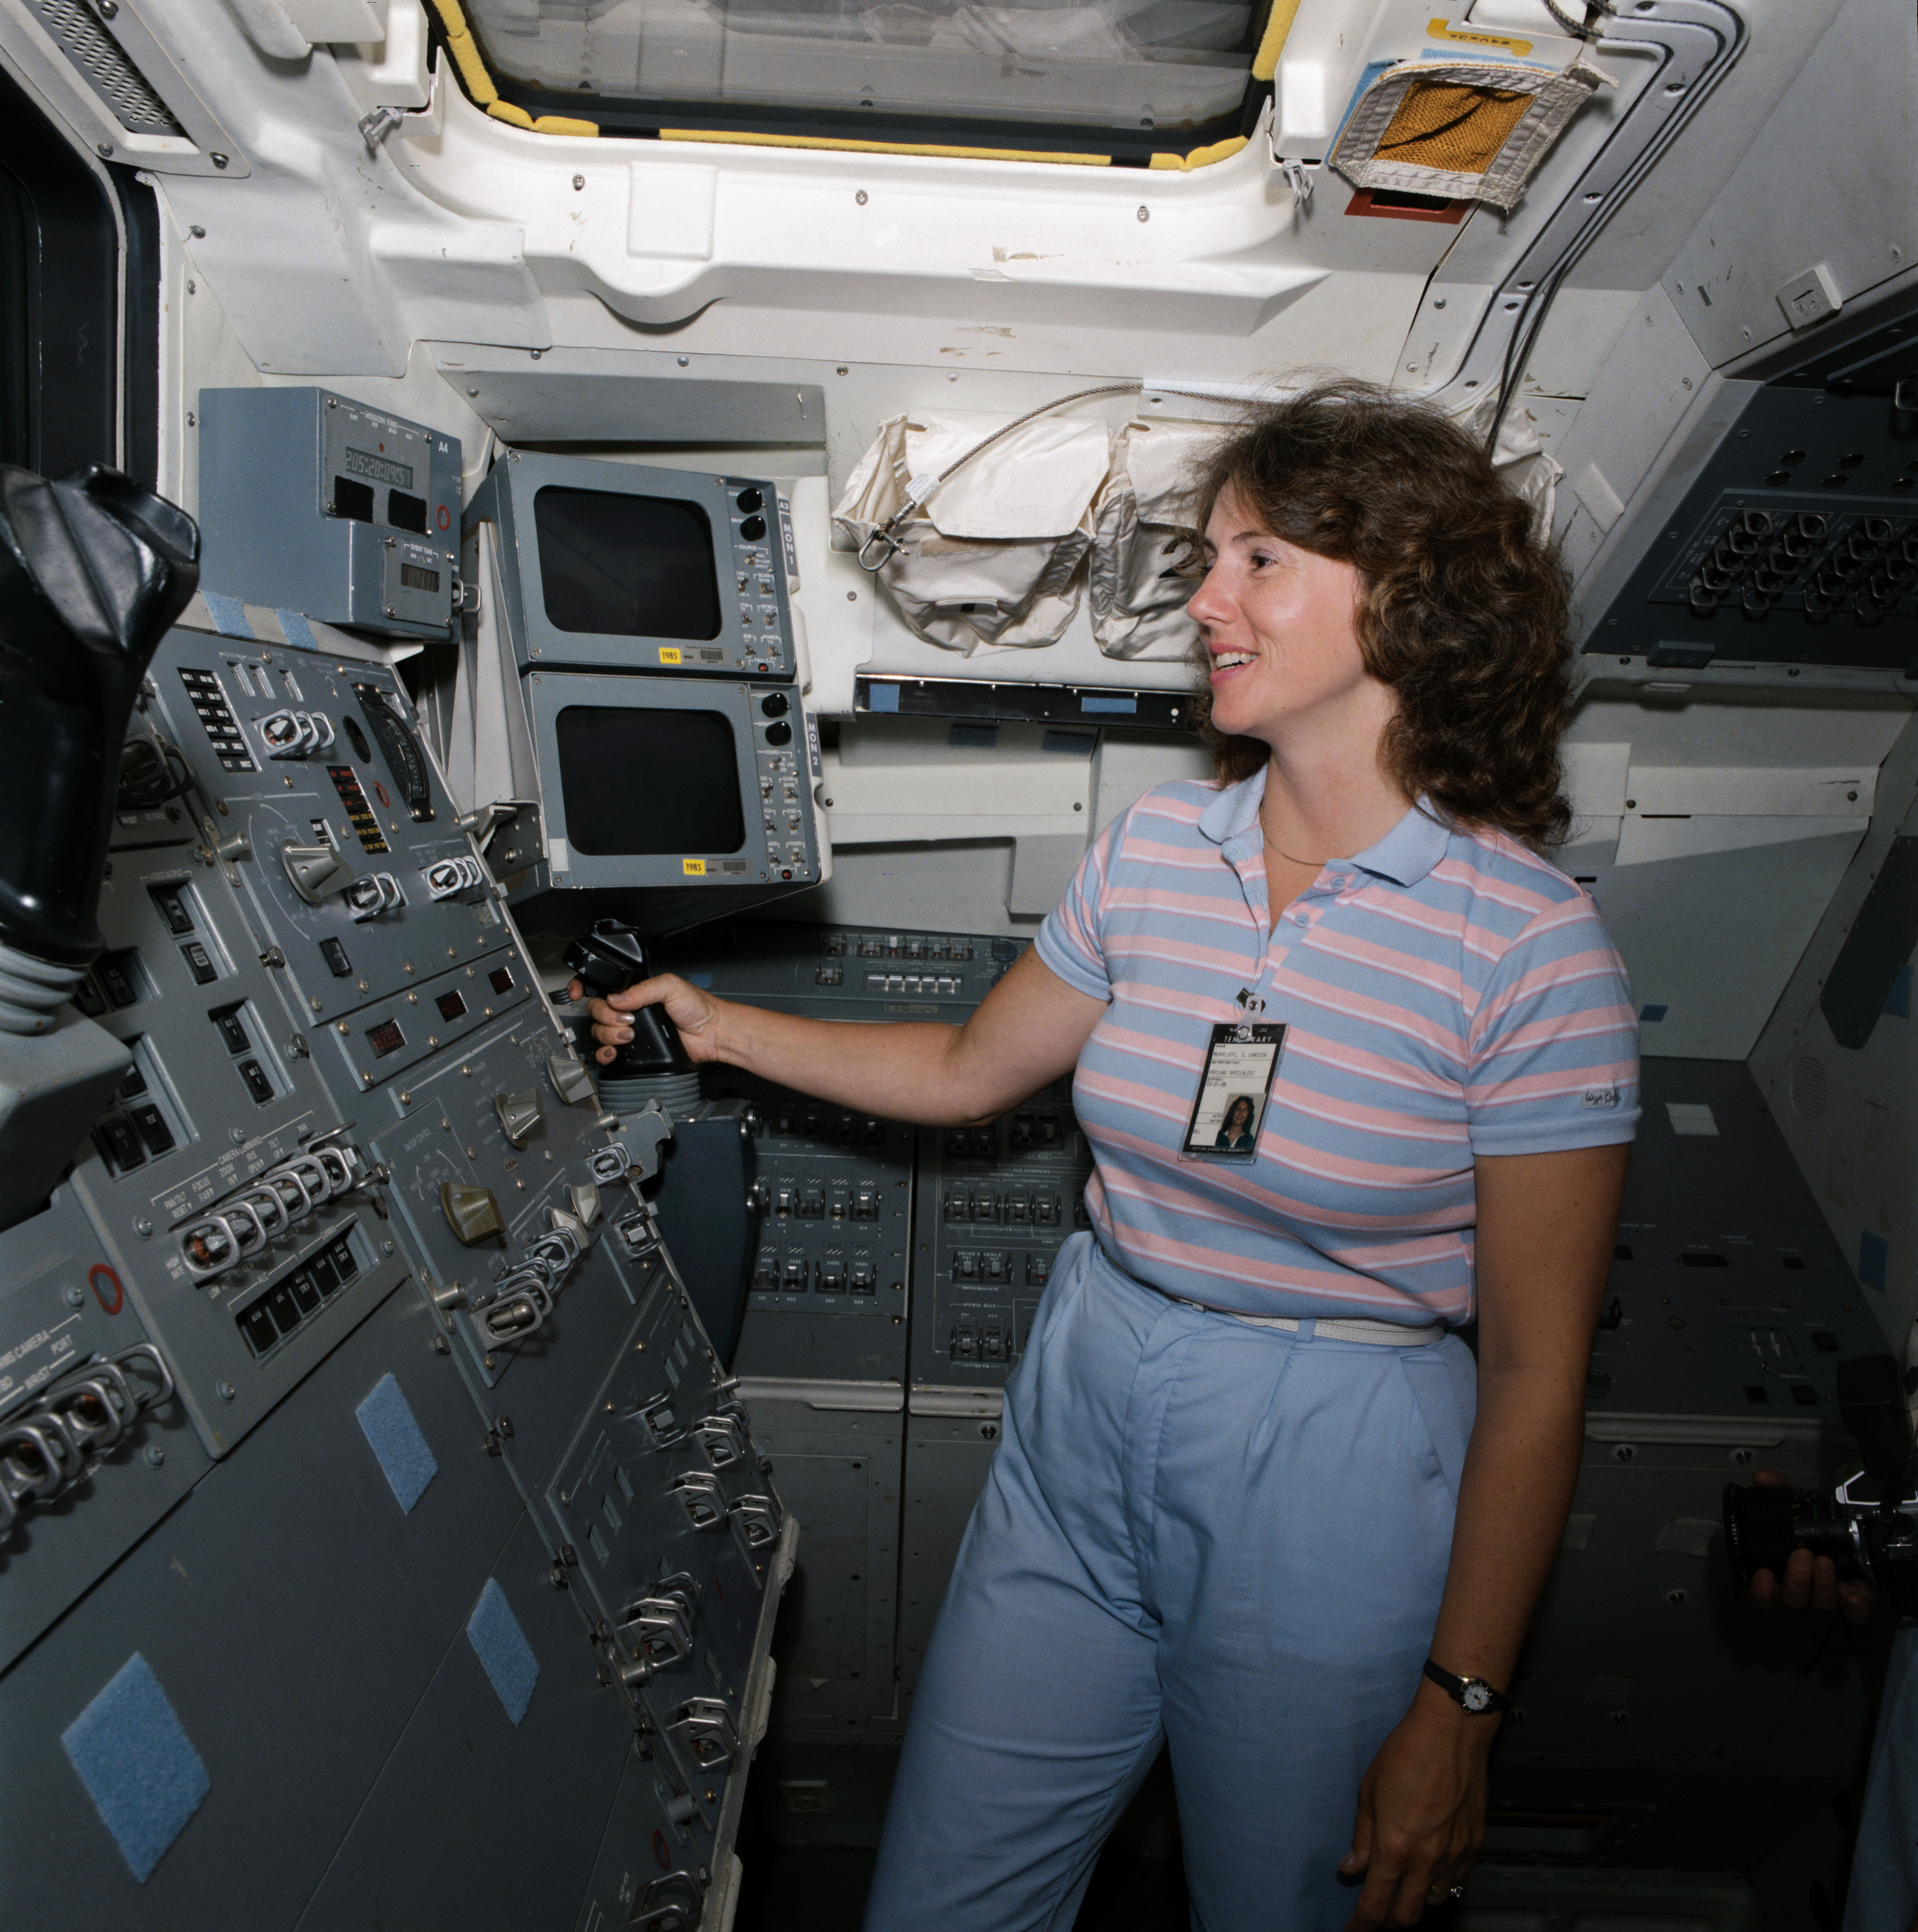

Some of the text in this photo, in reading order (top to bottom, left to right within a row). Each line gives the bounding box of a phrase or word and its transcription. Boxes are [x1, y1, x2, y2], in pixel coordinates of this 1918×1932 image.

[1449, 34, 1510, 45] BACKUP
[365, 412, 398, 428] MISSION TIME
[438, 441, 449, 454] A4
[779, 501, 790, 510] A3
[784, 523, 794, 553] MON
[410, 544, 423, 553] EVENT
[662, 651, 678, 660] 1985
[808, 723, 818, 766] MON 2
[686, 862, 702, 871] 1985
[145, 1113, 157, 1125] TEST
[297, 1122, 308, 1133] PAN
[268, 1137, 280, 1149] TILT
[217, 1148, 240, 1165] CAMERA
[246, 1150, 258, 1162] IRIS
[218, 1163, 235, 1178] ZOOM
[247, 1162, 262, 1174] OPEN
[192, 1176, 211, 1193] FOCUS
[164, 1191, 187, 1210] PAN/TILT
[198, 1189, 211, 1202] FAR
[171, 1204, 188, 1219] RESET
[321, 1225, 337, 1240] GAMMA
[257, 1272, 269, 1285] ALC
[13, 1330, 51, 1359] CAMERA
[50, 1333, 73, 1355] PORT
